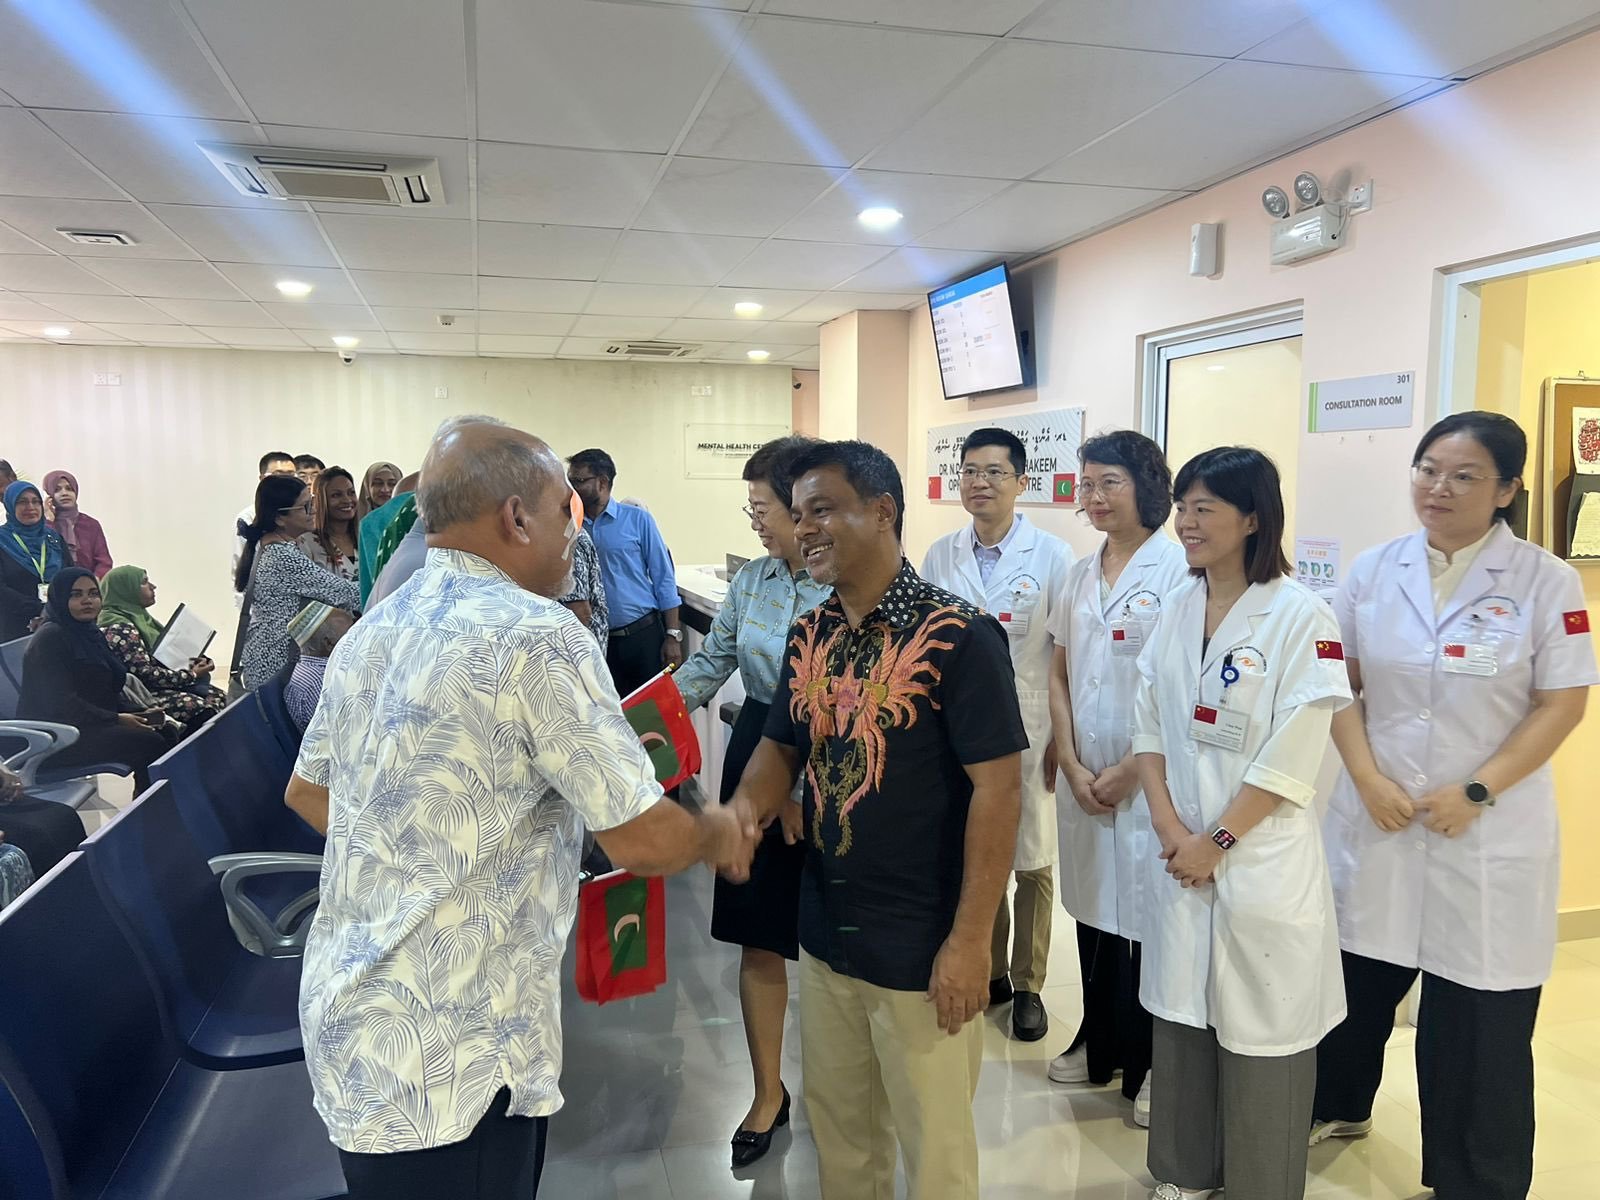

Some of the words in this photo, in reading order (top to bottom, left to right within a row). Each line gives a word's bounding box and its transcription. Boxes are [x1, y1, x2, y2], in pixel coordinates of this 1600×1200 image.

[1397, 374, 1411, 385] 301
[1324, 398, 1377, 411] CONSULTATION
[1378, 395, 1403, 406] ROOM
